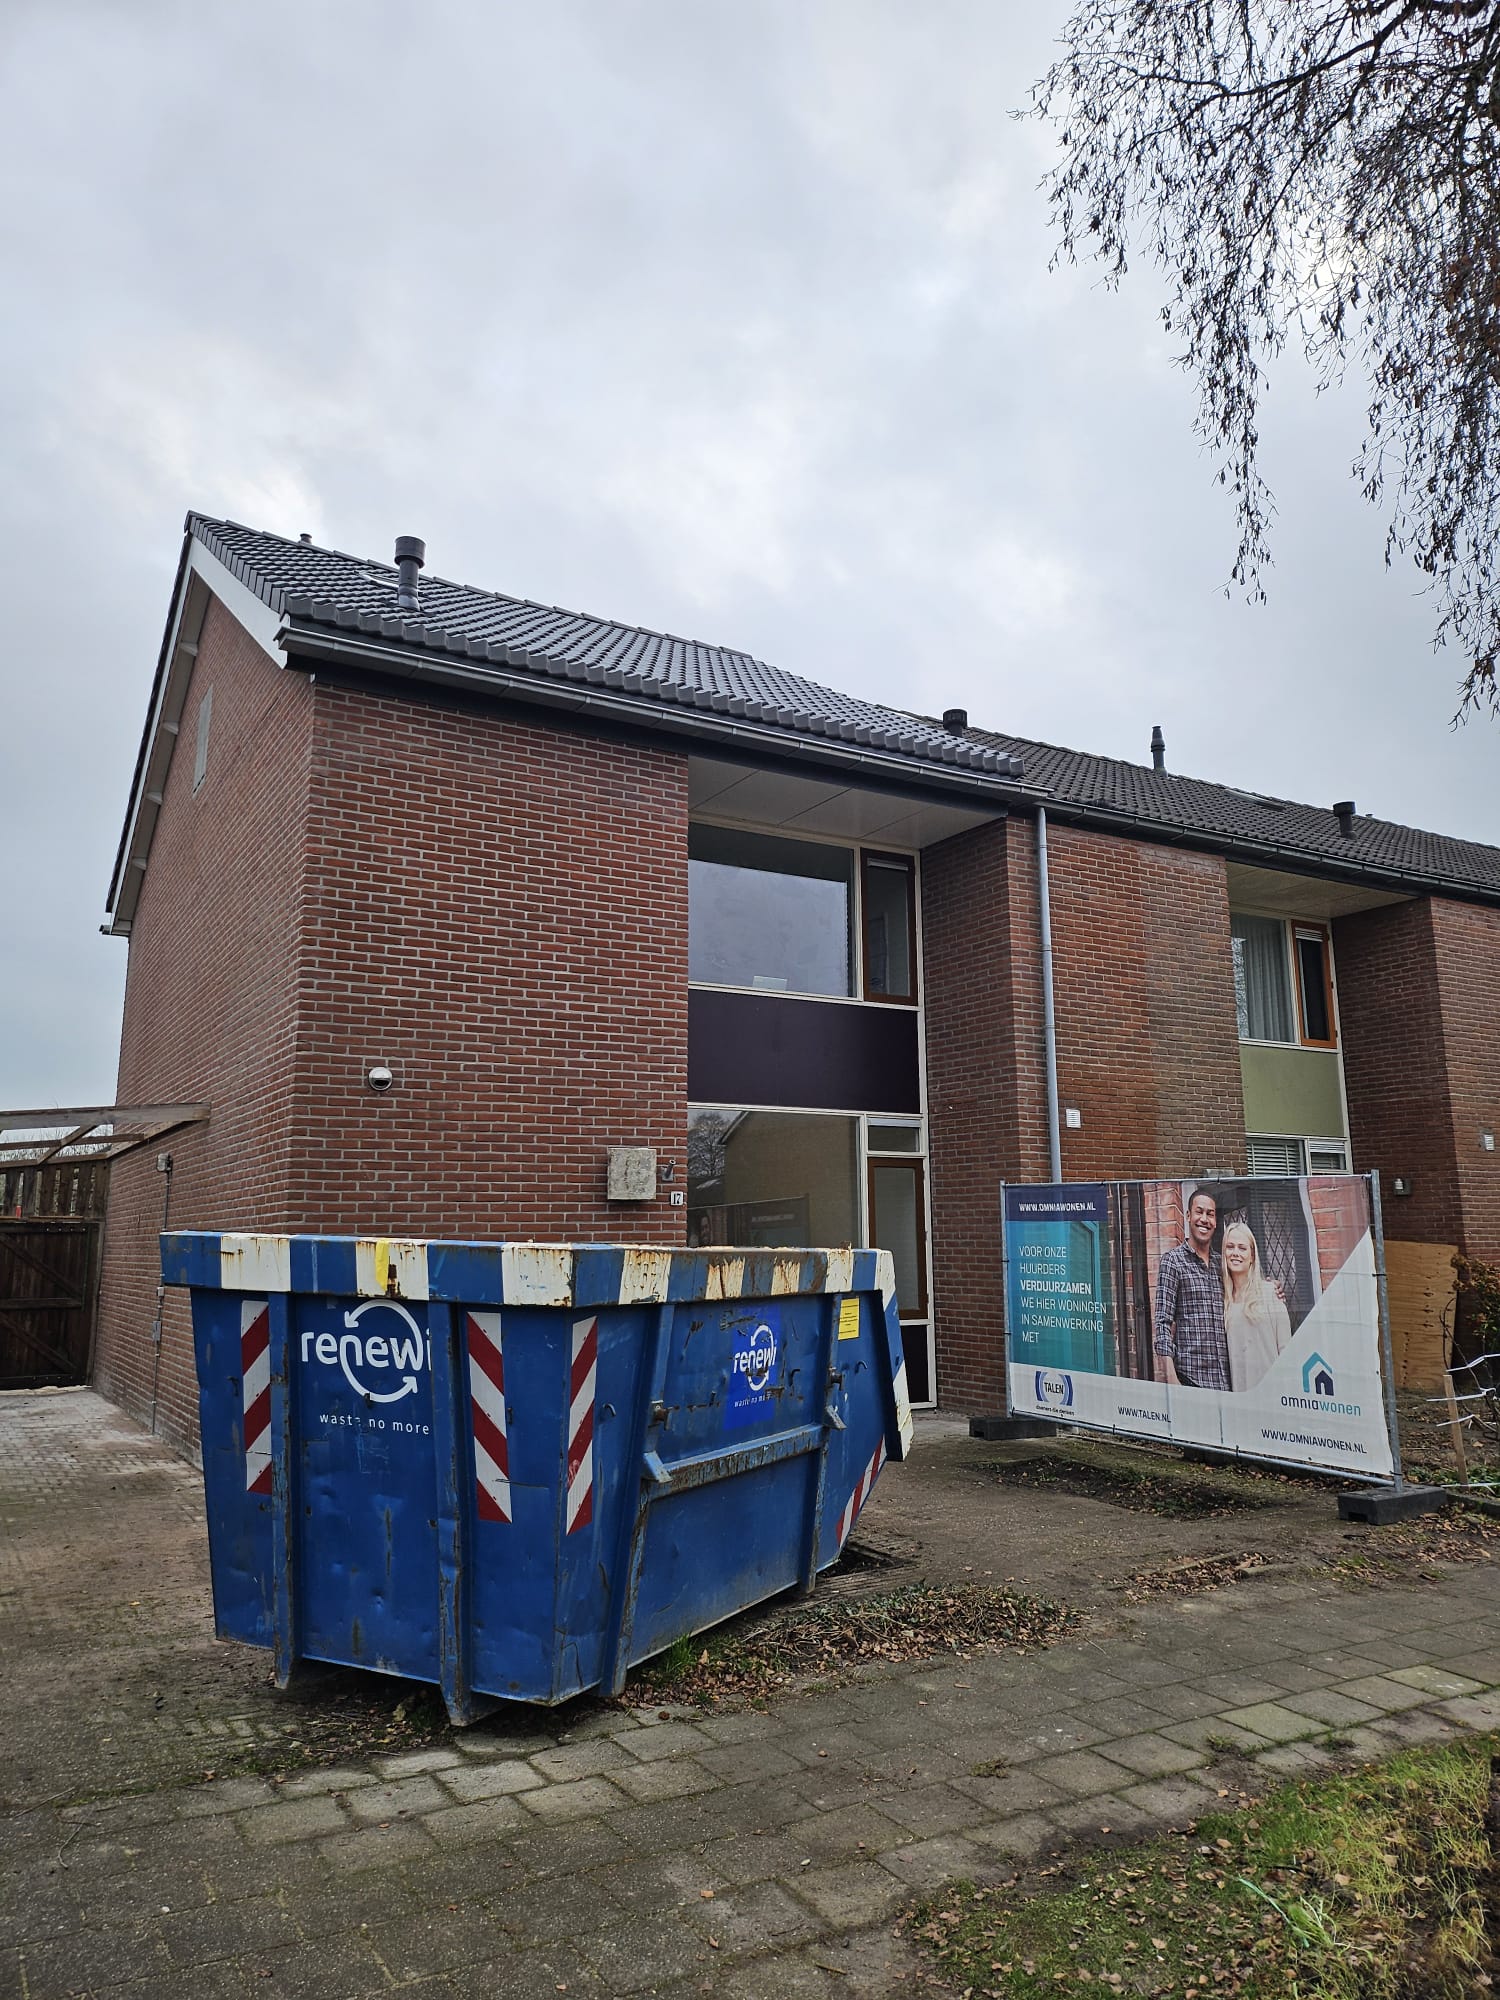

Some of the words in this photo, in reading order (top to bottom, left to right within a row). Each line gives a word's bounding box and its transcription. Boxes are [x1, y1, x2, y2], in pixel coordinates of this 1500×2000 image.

[673, 1193, 681, 1205] 17
[1019, 1202, 1096, 1212] WWW.OMNIAWONEN.NL
[1019, 1245, 1042, 1257] VOOR
[1044, 1246, 1067, 1258] ONZE
[1020, 1263, 1066, 1275] HUURDERS
[1020, 1280, 1092, 1295] VERDUURZAMEN
[1021, 1297, 1034, 1308] WE
[1036, 1299, 1057, 1310] HIER
[1058, 1301, 1107, 1314] WONINGEN
[1021, 1314, 1030, 1326] IN
[1032, 1316, 1104, 1332] SAMENWERKING
[1022, 1331, 1040, 1343] MET
[301, 1328, 432, 1371] renewi
[733, 1339, 777, 1373] renewi
[1043, 1382, 1064, 1394] TALEN
[1117, 1406, 1171, 1423] WWW.TALEN.NL
[1281, 1396, 1361, 1416] omniawonen
[369, 1418, 385, 1429] no
[392, 1421, 429, 1435] more
[1261, 1429, 1367, 1454] WWW.OMNIAWONEN.NL
